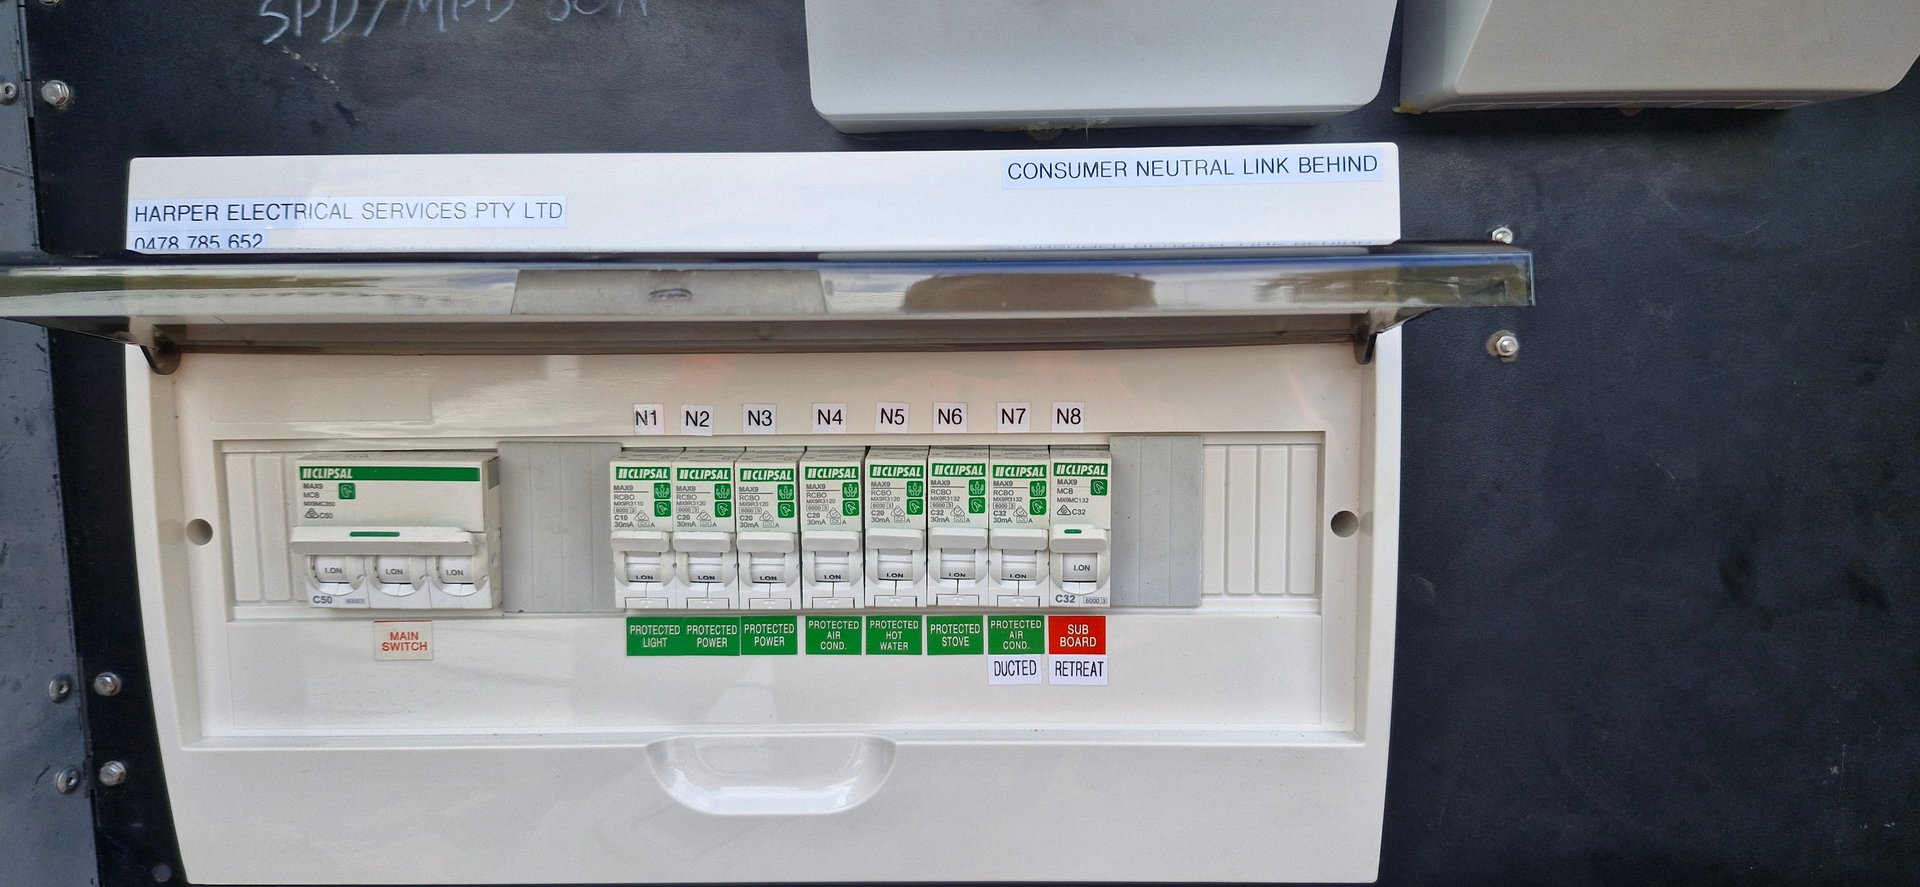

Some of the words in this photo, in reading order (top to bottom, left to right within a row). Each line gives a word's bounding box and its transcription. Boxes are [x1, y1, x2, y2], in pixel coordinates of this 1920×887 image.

[1007, 161, 1128, 180] CONSUMER
[1136, 159, 1235, 177] NEUTRAL
[1243, 157, 1289, 175] LINK
[1299, 155, 1378, 173] BEHIND
[135, 204, 219, 222] HARPER
[228, 202, 353, 221] ELECTRICAL
[361, 202, 466, 220] SERVICES
[475, 202, 514, 219] PTY
[524, 202, 563, 220] LTD
[135, 236, 179, 249] 0478
[187, 235, 220, 249] 785
[228, 233, 263, 249] 652
[635, 410, 659, 426] N1
[685, 411, 709, 427] N2
[748, 410, 773, 426] N3
[817, 409, 843, 425] N4
[880, 408, 905, 425] N5
[937, 408, 963, 425] N6
[1001, 408, 1026, 425] N7
[1056, 408, 1082, 425] N8
[312, 468, 353, 479] CLIPSAL
[628, 468, 668, 479] CLIPSAL
[689, 469, 728, 480] CLIPSAL
[752, 469, 792, 480] CLIPSAL
[817, 468, 856, 479] CLIPSAL
[881, 466, 921, 477] CLIPSAL
[944, 465, 983, 476] CLIPSAL
[1005, 466, 1044, 477] CLIPSAL
[1066, 464, 1106, 475] CLIPSAL
[313, 595, 333, 604] C50
[1055, 594, 1076, 604] C32
[630, 625, 681, 635] PROTECTED
[687, 624, 738, 635] PROTECTED
[744, 624, 795, 634] PROTECTED
[808, 620, 859, 630] PROTECTED
[870, 620, 919, 629] PROTECTED
[931, 624, 981, 634] PROTECTED
[990, 620, 1042, 629] PROTECTED
[1067, 624, 1089, 635] SUB
[390, 631, 419, 640] MAIN
[826, 631, 841, 640] AIR
[886, 631, 903, 640] HOT
[1009, 631, 1024, 639] AIR
[382, 642, 428, 652] SWITCH
[642, 638, 668, 648] LIGHT
[696, 638, 728, 648] POWER
[754, 637, 785, 647] POWER
[820, 642, 847, 650] COND.
[880, 642, 908, 651] WATER
[941, 637, 970, 647] STOVE
[1003, 641, 1030, 650] COND.
[1059, 636, 1097, 648] BOARD
[994, 660, 1037, 676] DUCTED
[1055, 661, 1104, 677] RETREAT
